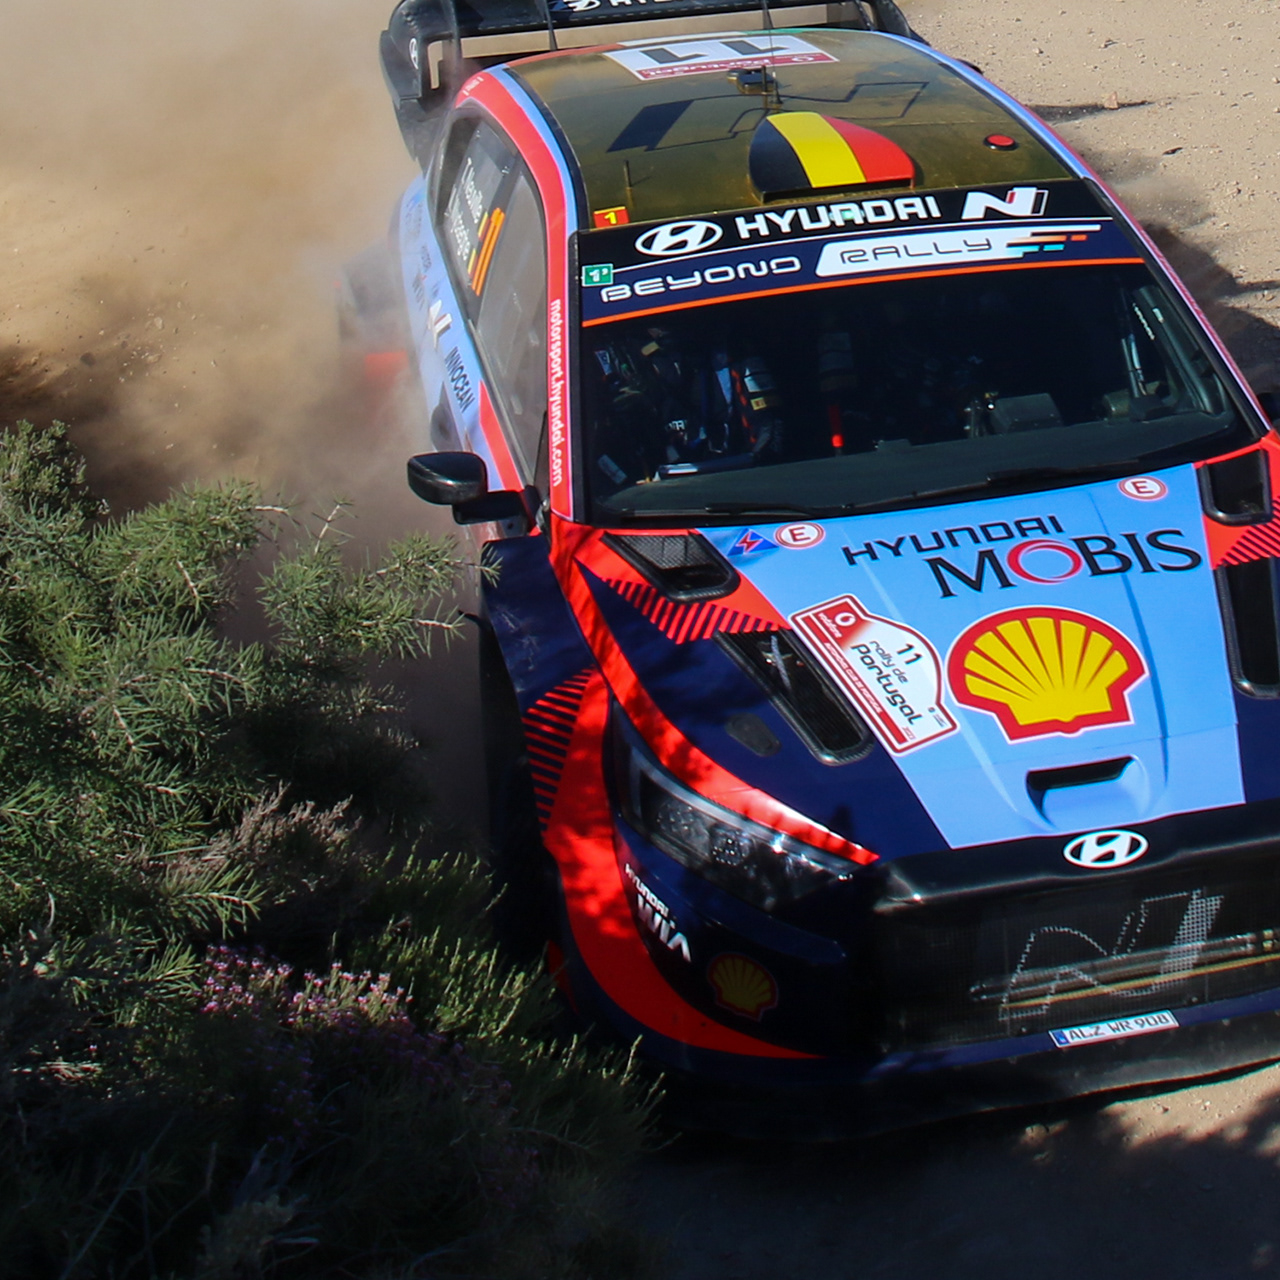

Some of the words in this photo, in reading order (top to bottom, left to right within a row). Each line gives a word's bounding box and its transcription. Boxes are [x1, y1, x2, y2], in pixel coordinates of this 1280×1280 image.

[604, 211, 617, 224] 1
[735, 196, 941, 239] HYUNDAI
[600, 256, 801, 302] BEYOND
[840, 238, 992, 264] RALLY
[445, 346, 475, 414] INNOCEAN
[548, 299, 565, 487] motorsport.hyundai.com
[1135, 480, 1154, 496] E
[788, 526, 809, 543] E
[842, 514, 1064, 565] HYUNDAI
[923, 529, 1201, 598] MOBIS
[818, 612, 842, 639] vodafone
[870, 640, 895, 668] rally
[892, 666, 908, 684] de
[896, 643, 923, 665] 11
[851, 643, 923, 726] Portugal
[1107, 1019, 1133, 1034] WR
